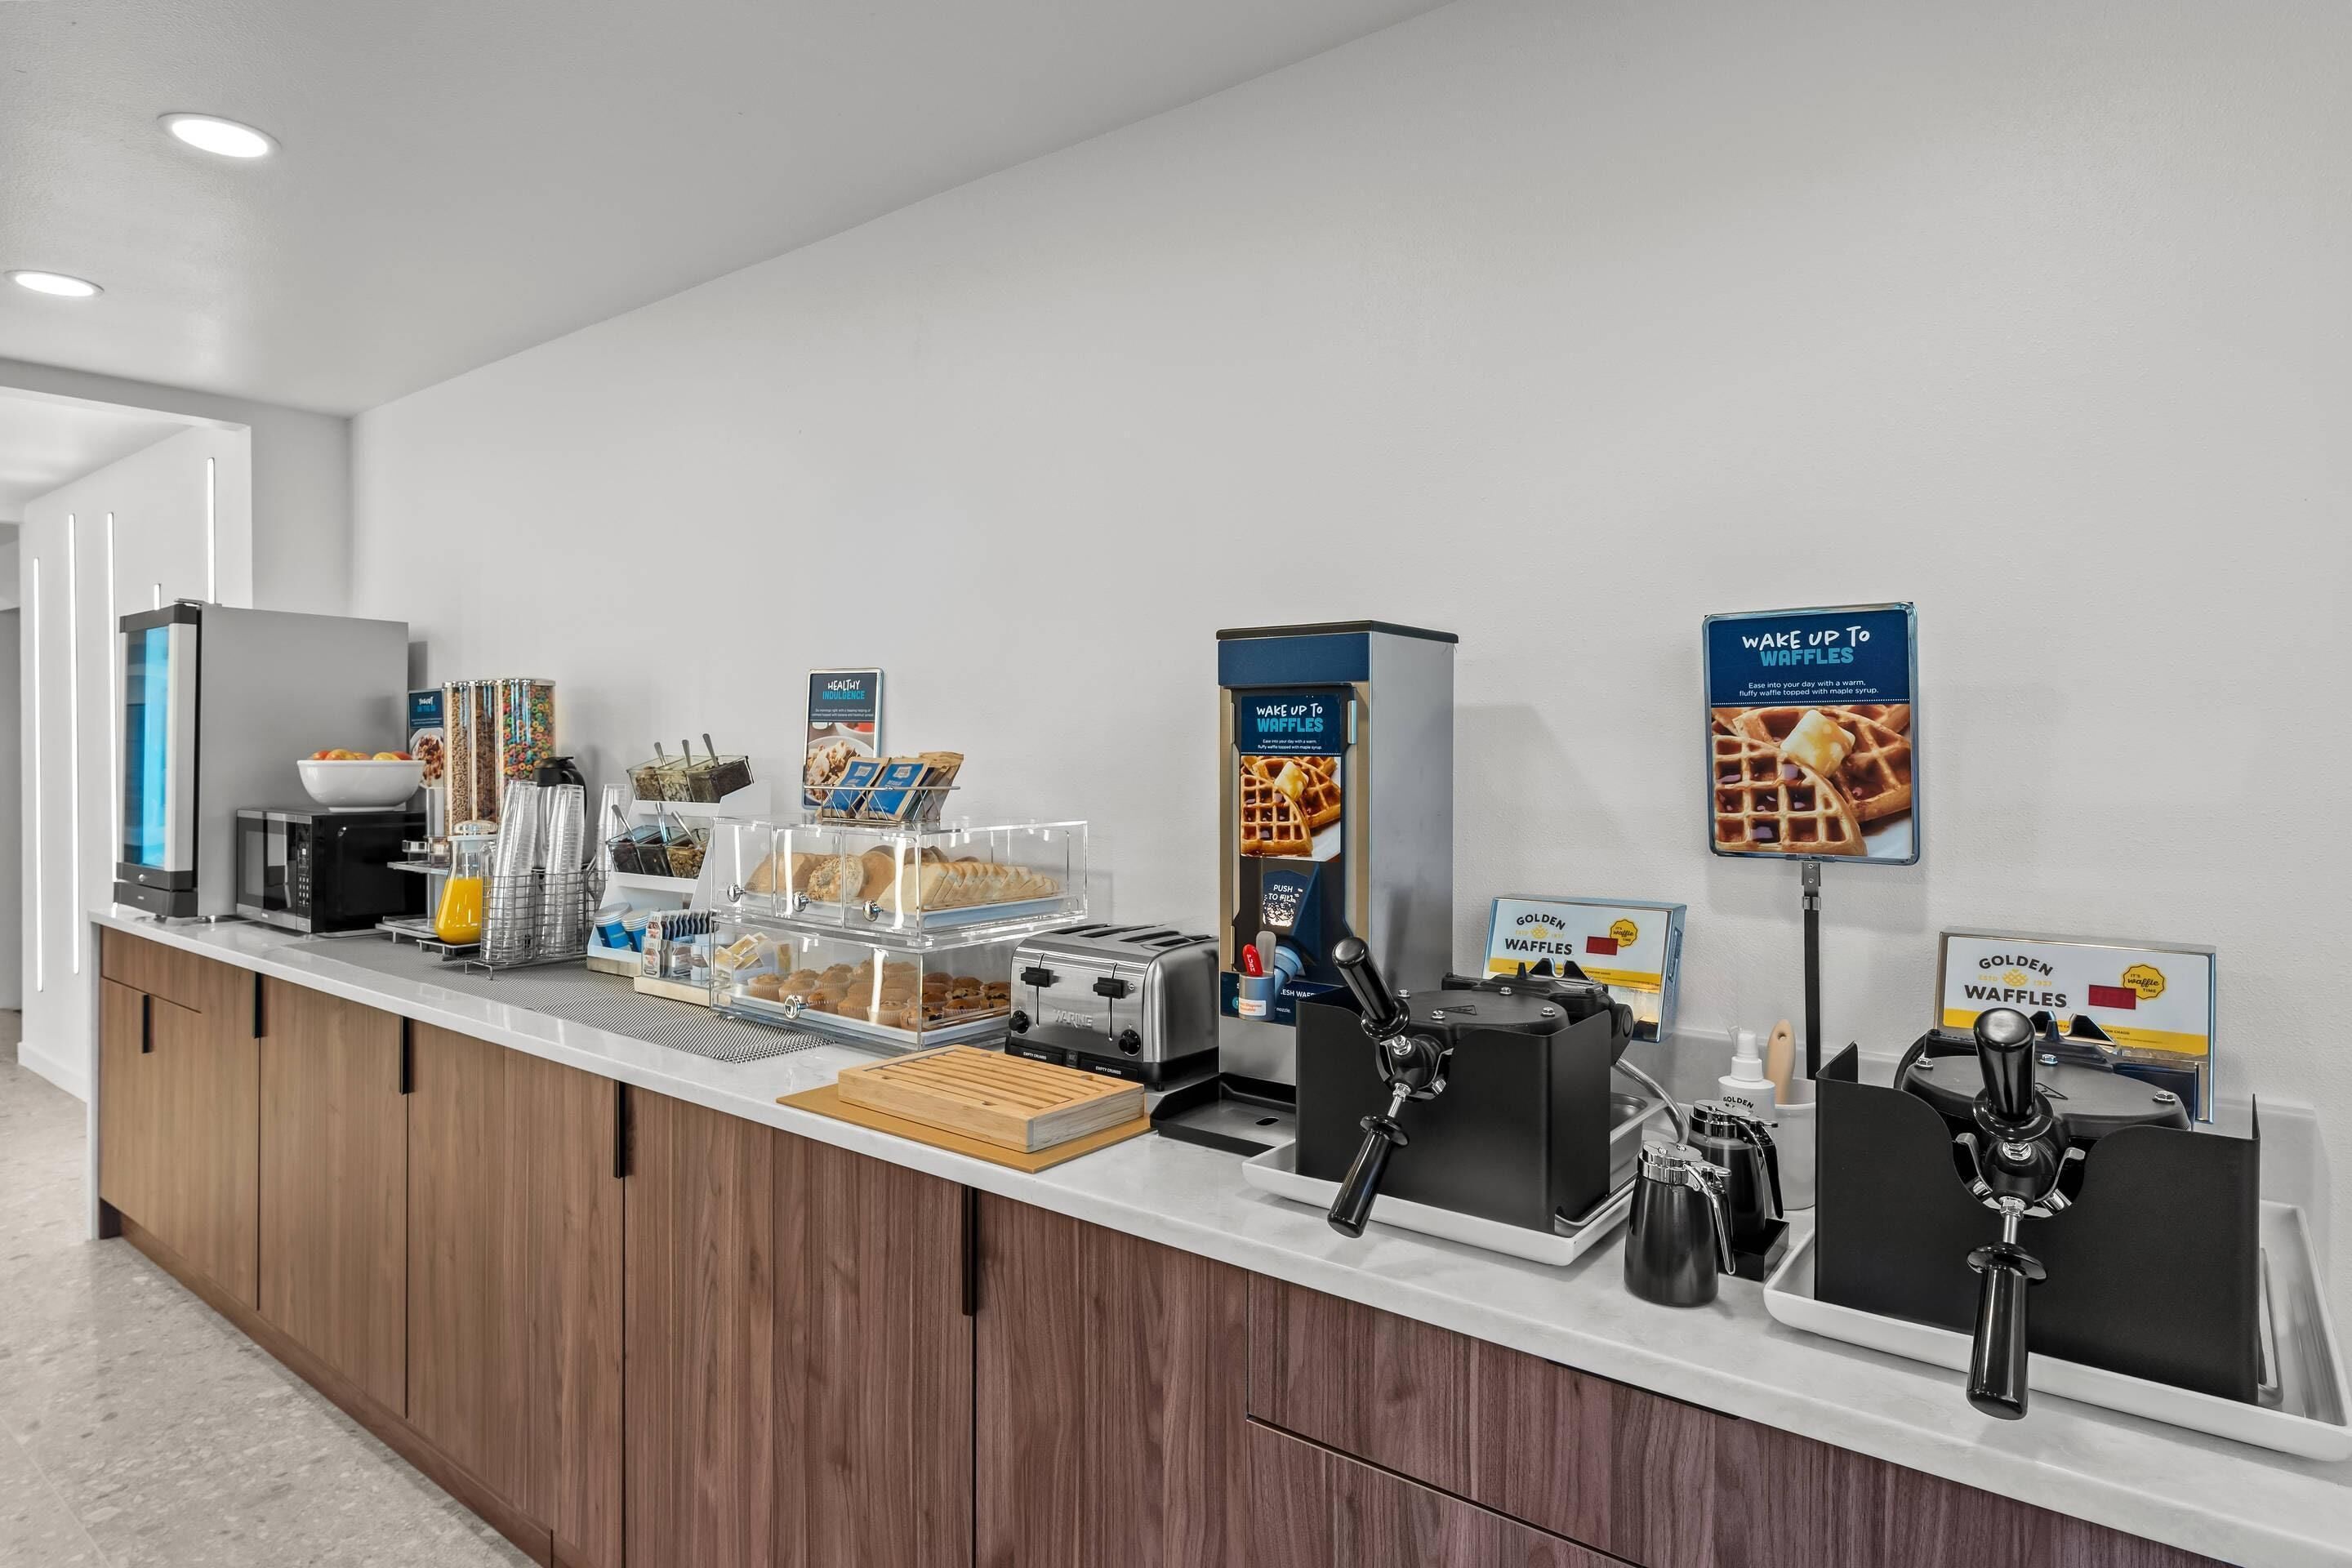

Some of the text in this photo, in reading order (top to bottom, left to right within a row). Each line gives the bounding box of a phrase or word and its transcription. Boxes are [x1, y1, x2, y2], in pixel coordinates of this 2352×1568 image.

[1742, 630, 1802, 651] WAKE
[1808, 630, 1839, 646] UP
[1759, 647, 1855, 666] WAFFLES
[827, 679, 861, 692] HEALTHY
[822, 690, 865, 700] INDULGENCE
[1256, 704, 1288, 717] WAKE
[1290, 705, 1307, 715] UP
[1257, 717, 1324, 733] WAFFLES
[1273, 884, 1294, 893] PUSH
[1517, 914, 1566, 930] GOLDEN
[1505, 938, 1572, 955] WAFFLES
[1979, 955, 2053, 976] GOLDEN
[2127, 978, 2159, 988] waffle
[1964, 985, 2067, 1008] WAFFLES
[1723, 1096, 1753, 1108] GOLDEN
